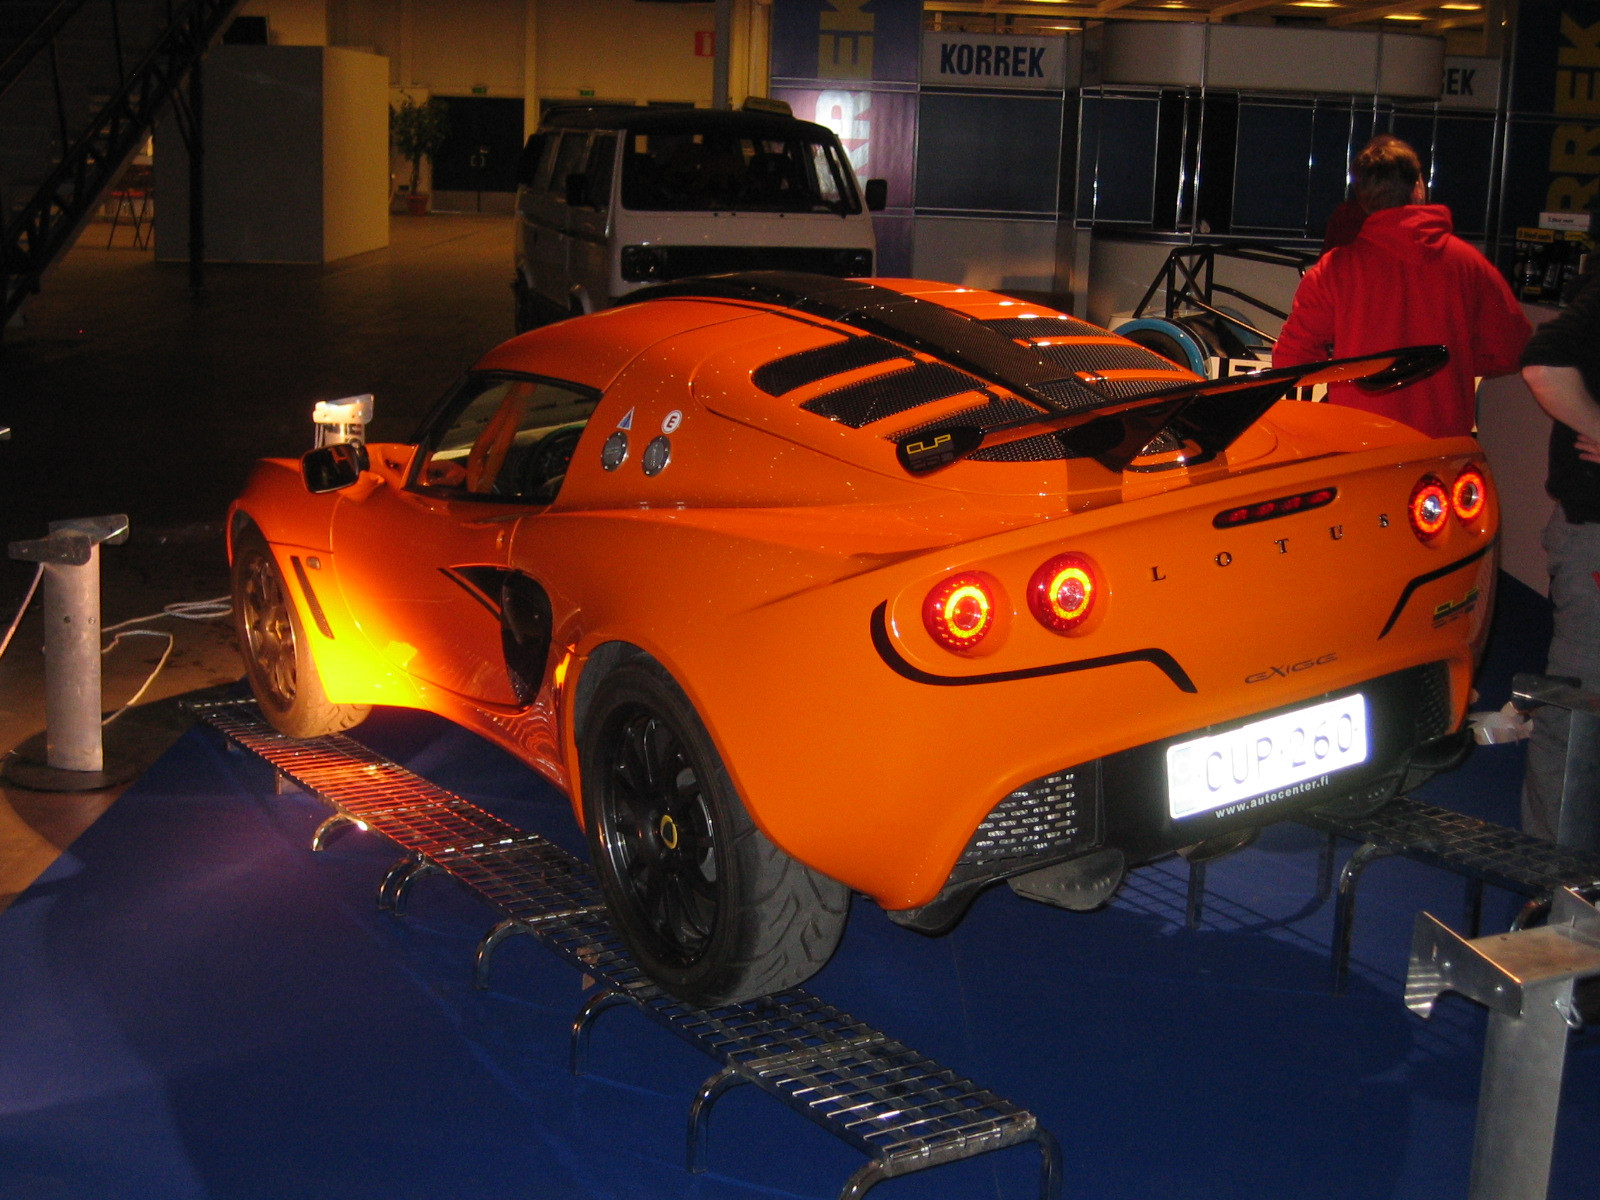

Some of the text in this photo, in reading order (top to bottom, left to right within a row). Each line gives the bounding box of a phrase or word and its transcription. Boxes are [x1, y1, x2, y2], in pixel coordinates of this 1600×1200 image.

[940, 43, 1045, 79] KORREK
[666, 415, 678, 429] E
[906, 434, 952, 455] CUP
[1151, 512, 1391, 583] LOTUS
[1214, 774, 1330, 820] www.autocenter.fi
